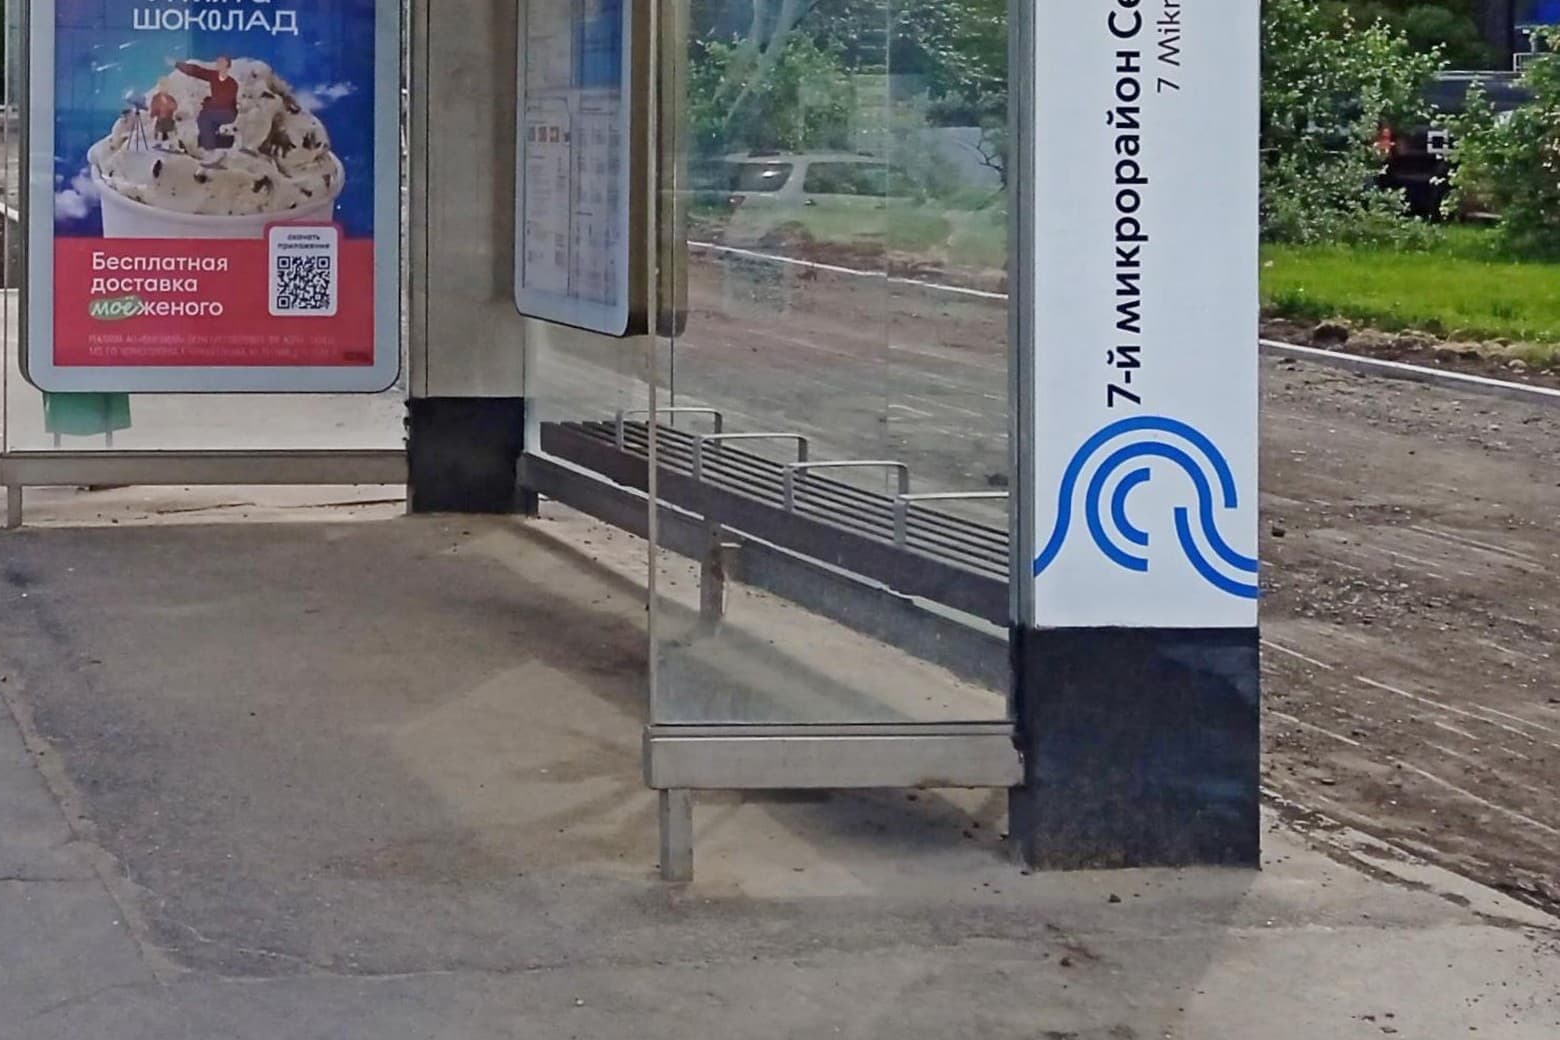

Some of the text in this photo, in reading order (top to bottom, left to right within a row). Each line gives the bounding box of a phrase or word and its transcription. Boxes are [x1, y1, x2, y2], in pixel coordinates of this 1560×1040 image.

[133, 8, 298, 36] ШОКОЛАД
[1157, 77, 1180, 93] 7
[1107, 51, 1149, 334] микрорайон
[91, 252, 228, 272] Бесплатная
[90, 277, 198, 294] доставка
[1107, 346, 1141, 408] 7-й
